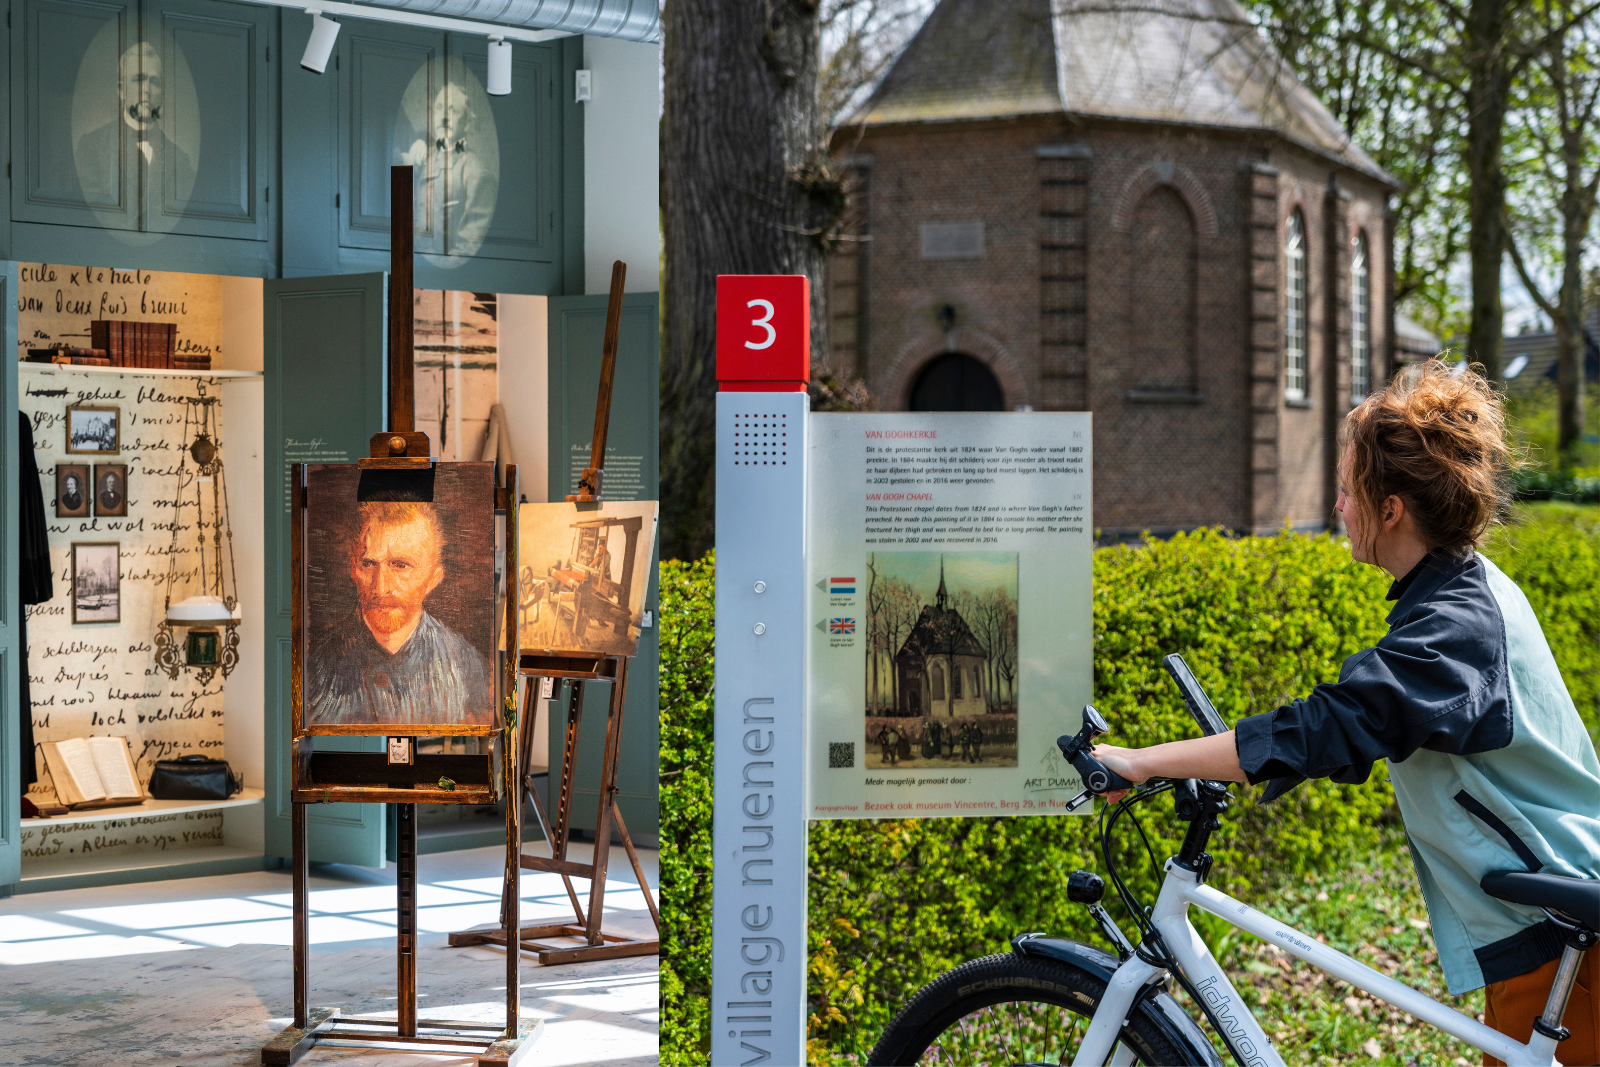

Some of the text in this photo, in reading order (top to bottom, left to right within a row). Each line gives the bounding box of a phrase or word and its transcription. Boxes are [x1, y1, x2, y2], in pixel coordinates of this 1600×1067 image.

[744, 299, 777, 350] 3
[865, 430, 938, 439] VAN GOGHKERKJE
[896, 446, 932, 454] protestantse
[1010, 446, 1028, 454] Goghs
[866, 456, 890, 464] preekte.
[939, 456, 947, 464] hij
[959, 456, 985, 464] schilderij
[1002, 456, 1012, 464] zijn
[889, 467, 910, 475] dijbeen
[925, 467, 952, 475] gebroken
[963, 467, 975, 475] lang
[977, 467, 985, 475] op
[1018, 467, 1038, 475] liggen.
[1051, 467, 1077, 475] schilderij
[890, 477, 915, 485] gestolen
[965, 477, 995, 485] gevonden.
[865, 493, 933, 501] VAN GOGH CHAPEL
[914, 505, 935, 513] chapel
[1042, 505, 1062, 513] Gogh's
[865, 516, 893, 524] preached.
[934, 516, 958, 524] painting
[905, 526, 920, 534] thigh
[1011, 526, 1024, 534] long
[1026, 526, 1045, 534] period.
[1059, 526, 1083, 534] painting
[865, 777, 884, 786] Mede
[886, 777, 916, 787] mogelijk
[918, 777, 949, 786] gemaakt
[1023, 778, 1046, 790] ART
[814, 804, 859, 813] #vangoghvillage
[864, 801, 895, 811] Bezoek
[897, 801, 913, 810] ook
[916, 801, 952, 810] museum
[954, 800, 998, 810] Vincentre,
[1000, 799, 1020, 810] Berg
[1022, 799, 1036, 809] 29,
[1038, 799, 1047, 808] in
[727, 697, 785, 1067] village nuenen
[957, 976, 1069, 997] SCHWALBE
